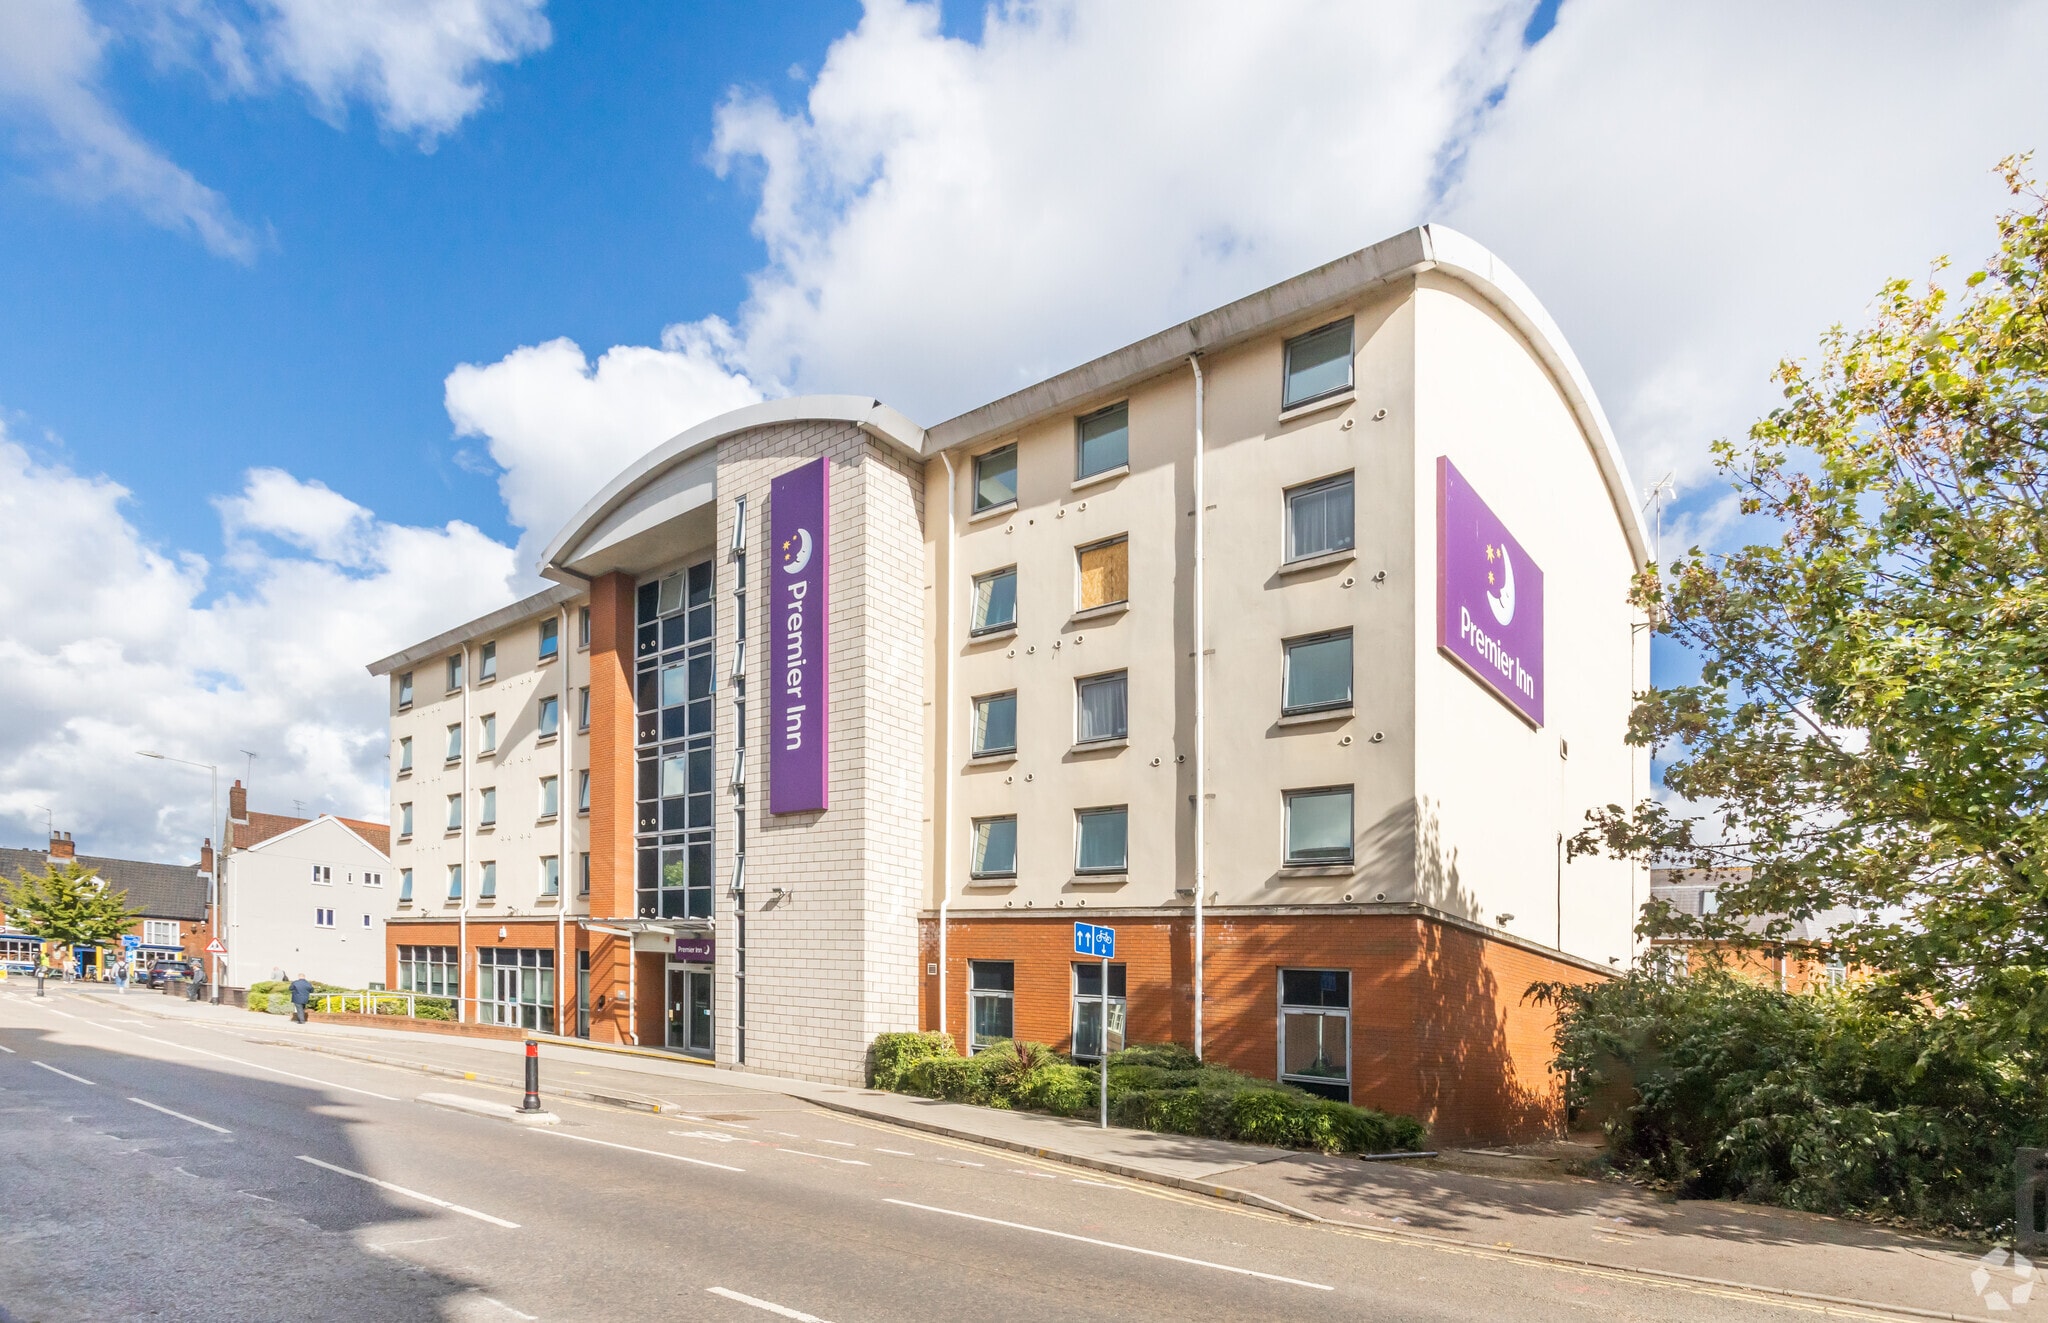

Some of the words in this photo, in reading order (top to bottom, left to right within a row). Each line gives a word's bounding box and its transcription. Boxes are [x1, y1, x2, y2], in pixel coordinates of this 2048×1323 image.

[787, 581, 807, 698] Premier
[1461, 606, 1514, 680] Premier
[1516, 657, 1534, 699] Inn
[786, 704, 806, 750] Inn
